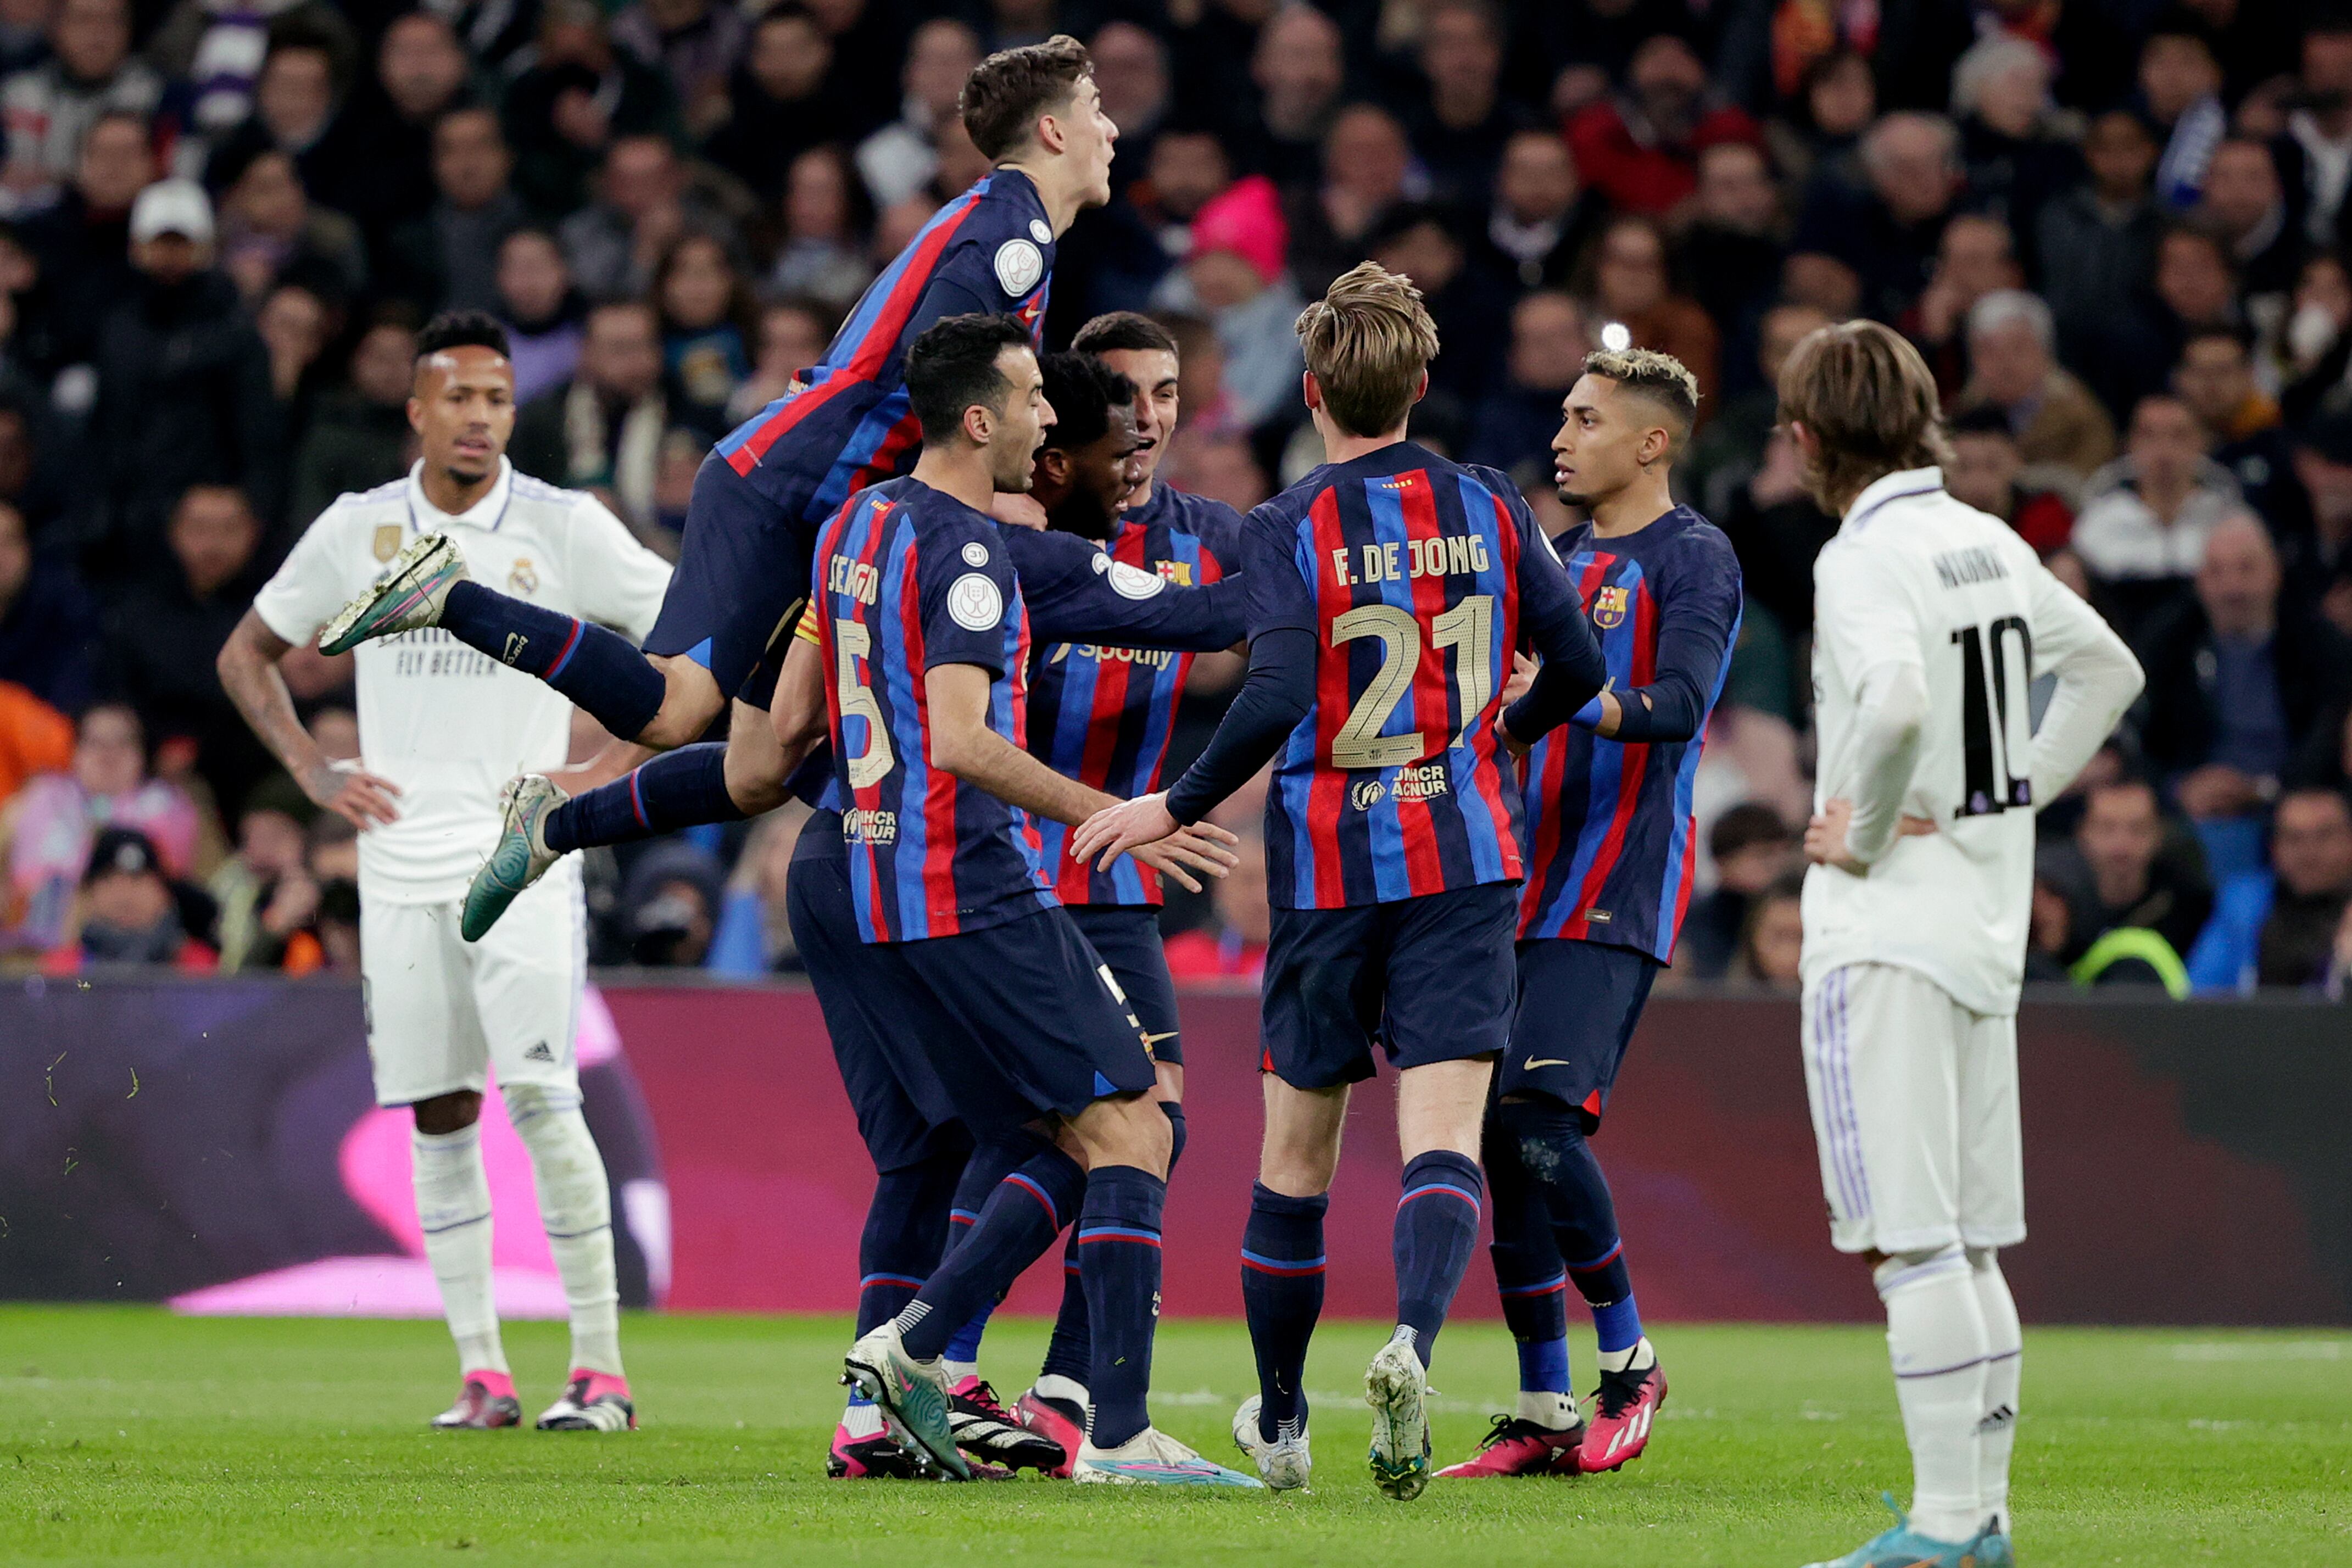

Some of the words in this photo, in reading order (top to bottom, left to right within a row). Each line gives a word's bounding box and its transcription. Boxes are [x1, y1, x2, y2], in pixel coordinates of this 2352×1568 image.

[1332, 548, 1358, 586] F.
[1363, 542, 1401, 583] DE
[1408, 534, 1489, 578] JONG
[836, 619, 895, 789] 5
[1332, 595, 1494, 767] 21
[1951, 616, 2031, 819] 10
[862, 824, 896, 839] NUR
[1391, 780, 1447, 796] ACNUR
